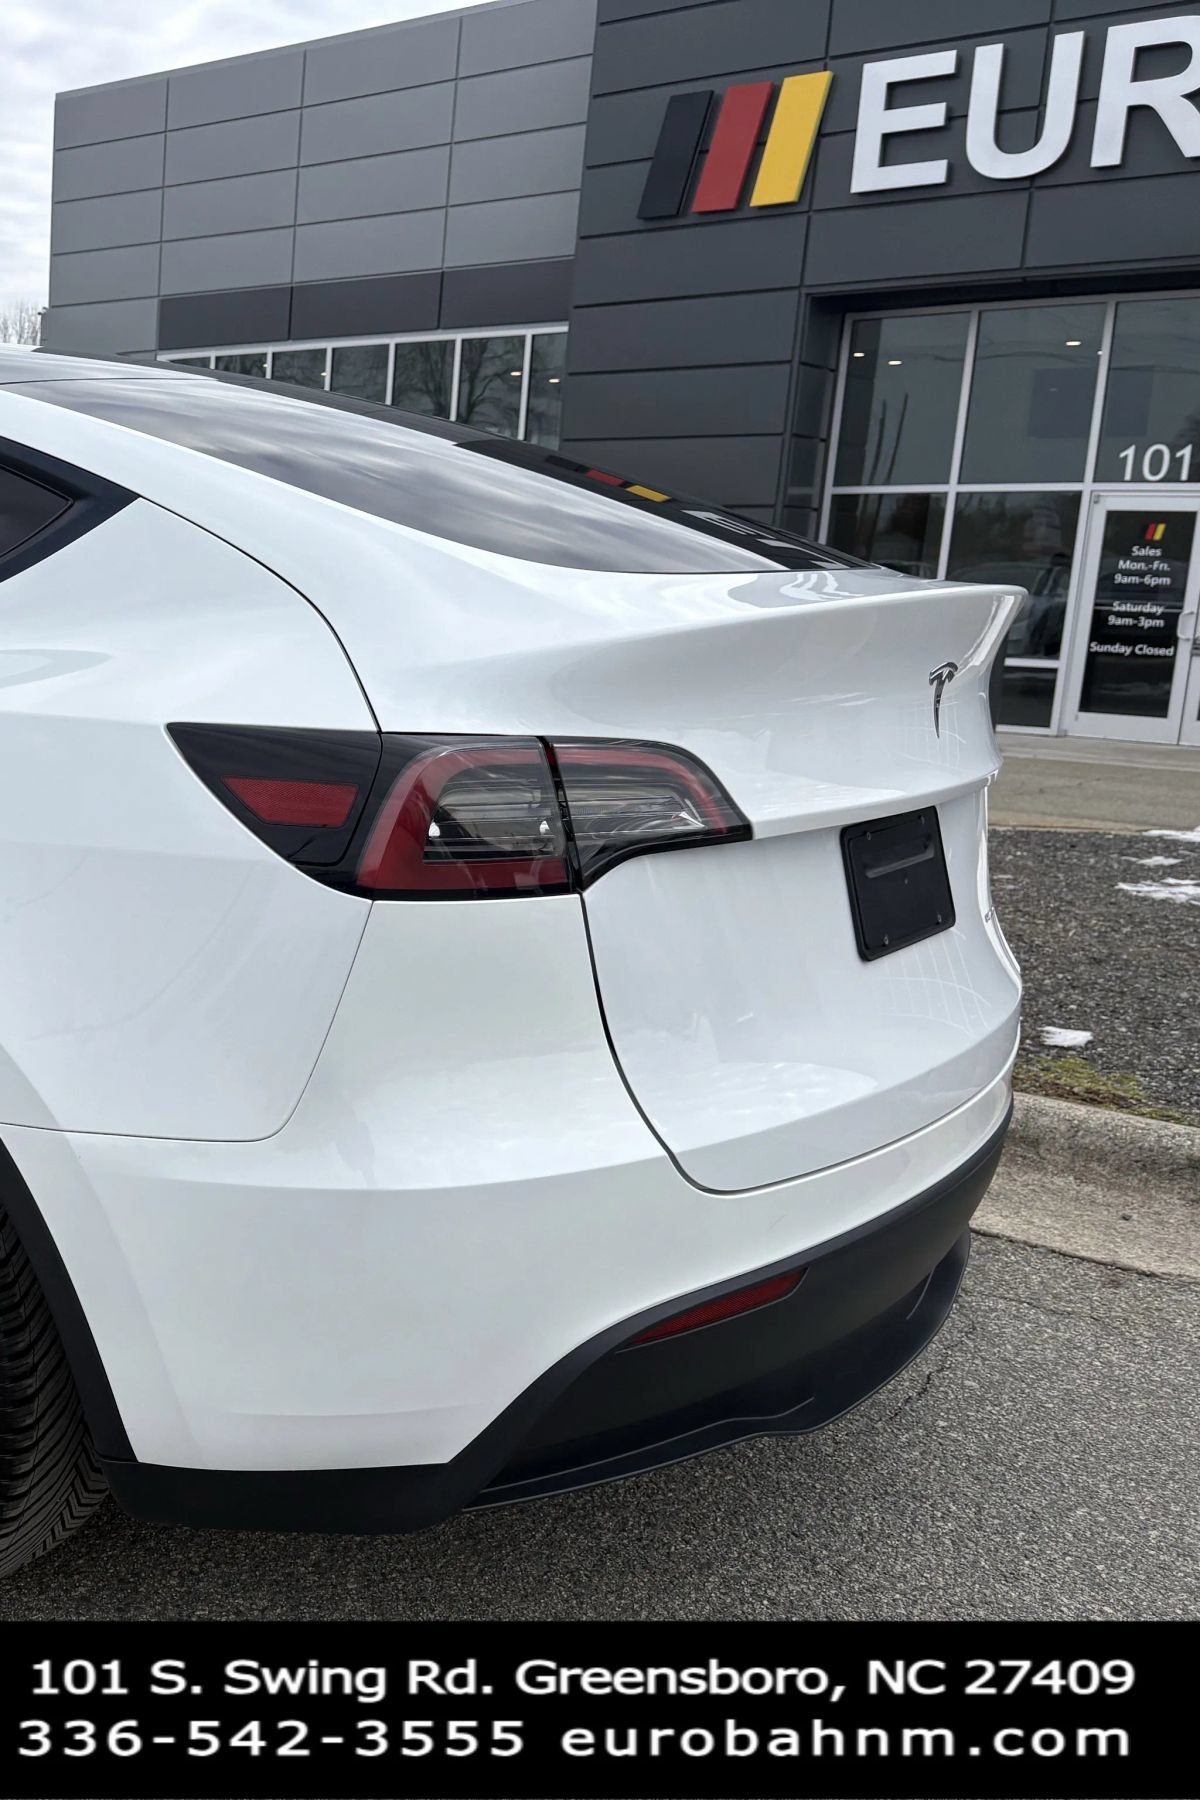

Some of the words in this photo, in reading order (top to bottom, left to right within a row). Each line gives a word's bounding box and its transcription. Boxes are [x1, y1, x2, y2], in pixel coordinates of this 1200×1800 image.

[1119, 443, 1192, 481] 101
[1131, 545, 1162, 557] Sales
[1113, 573, 1171, 587] 9am-6pm
[1112, 601, 1165, 616] Saturday
[1107, 614, 1165, 629] 9am-3pm
[1089, 641, 1133, 656] Sunday
[1134, 644, 1175, 657] Closed
